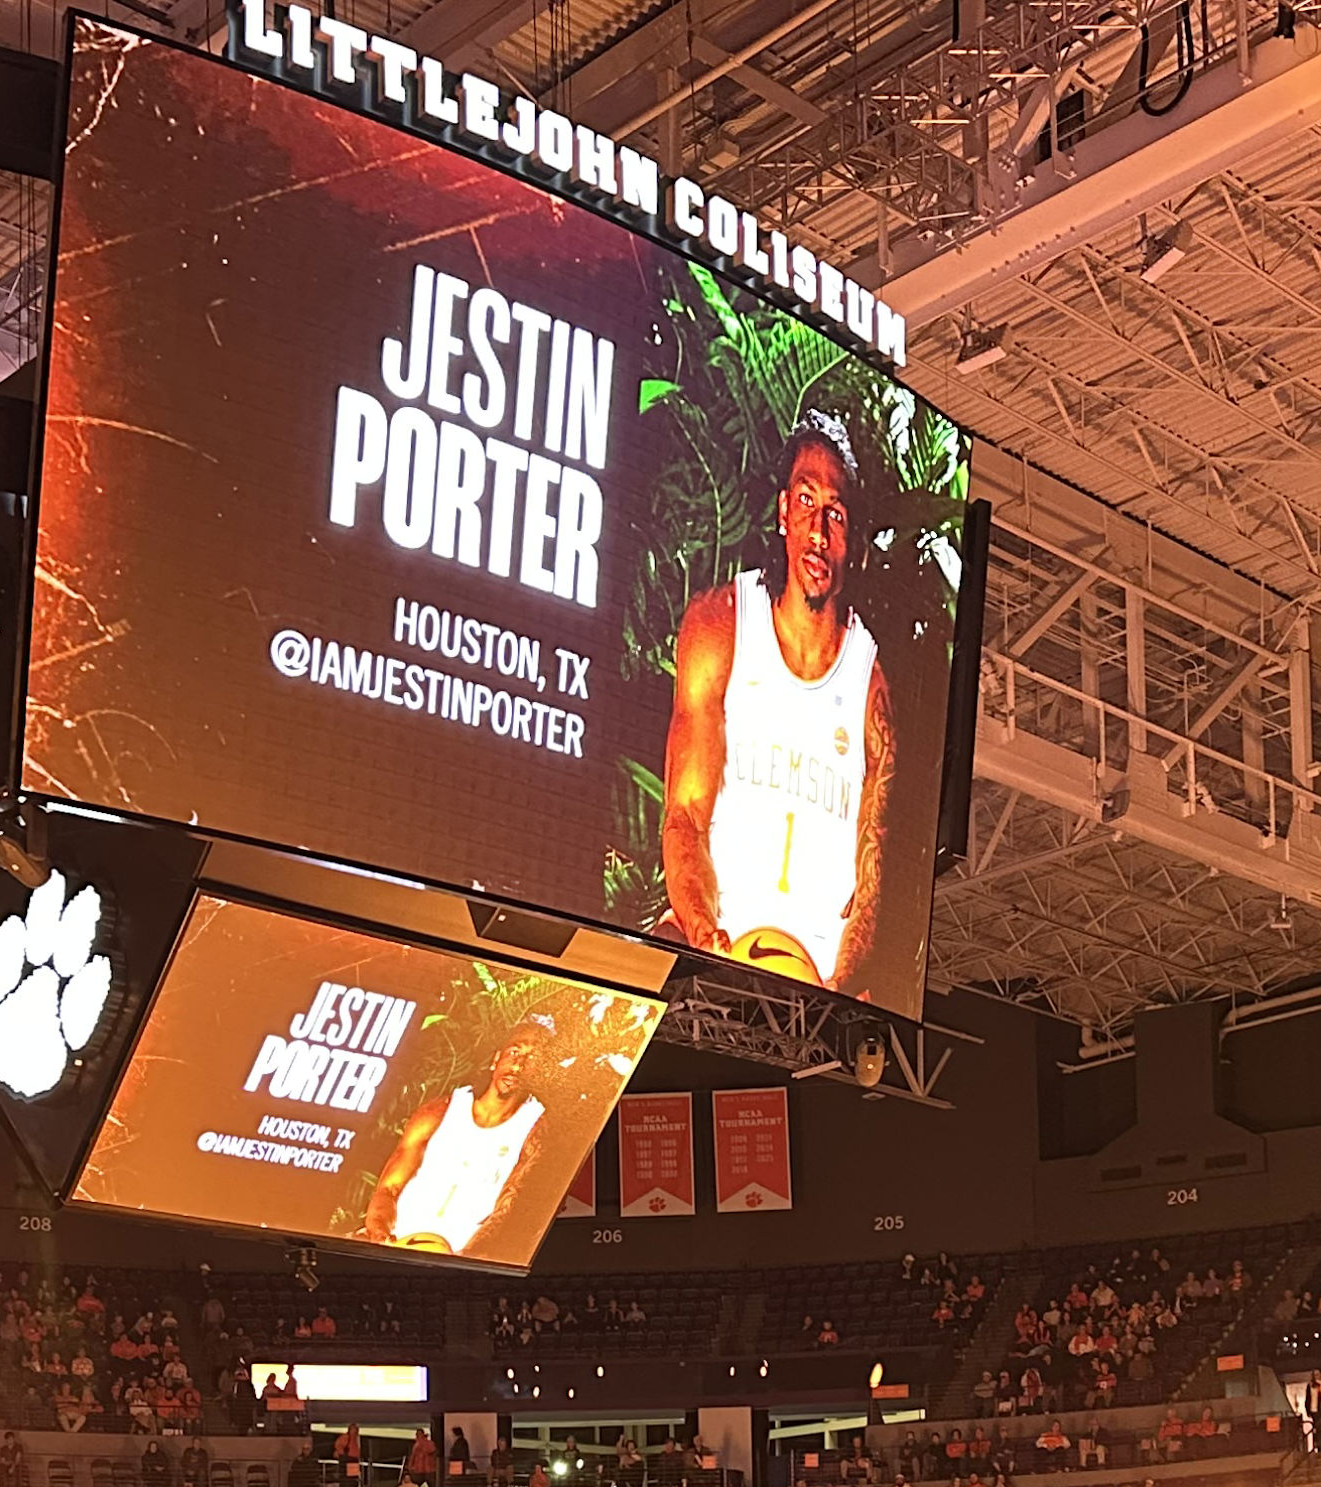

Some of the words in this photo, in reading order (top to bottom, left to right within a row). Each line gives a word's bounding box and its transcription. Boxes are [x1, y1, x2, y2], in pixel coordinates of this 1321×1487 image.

[242, 0, 658, 216] LITTLEJOHN
[674, 176, 907, 368] COLISEUM
[381, 264, 614, 470] JESTIN
[329, 385, 603, 609] PORTER
[394, 597, 546, 693] HOUSTON,
[555, 648, 590, 700] TX
[270, 629, 585, 758] @IAMJESTINPORTER
[289, 981, 417, 1057] JESTIN
[243, 1034, 388, 1113] PORTER
[624, 1122, 686, 1133] TOURNAMENT
[643, 1115, 668, 1123] NCAA
[719, 1117, 783, 1128] TOURNAMENT
[738, 1110, 763, 1119] NCAA
[257, 1115, 331, 1148] HOUSTON,
[334, 1128, 356, 1150] TX
[1166, 1188, 1198, 1206] 204
[19, 1215, 53, 1232] 208
[873, 1215, 905, 1231] 205
[592, 1229, 623, 1245] 206
